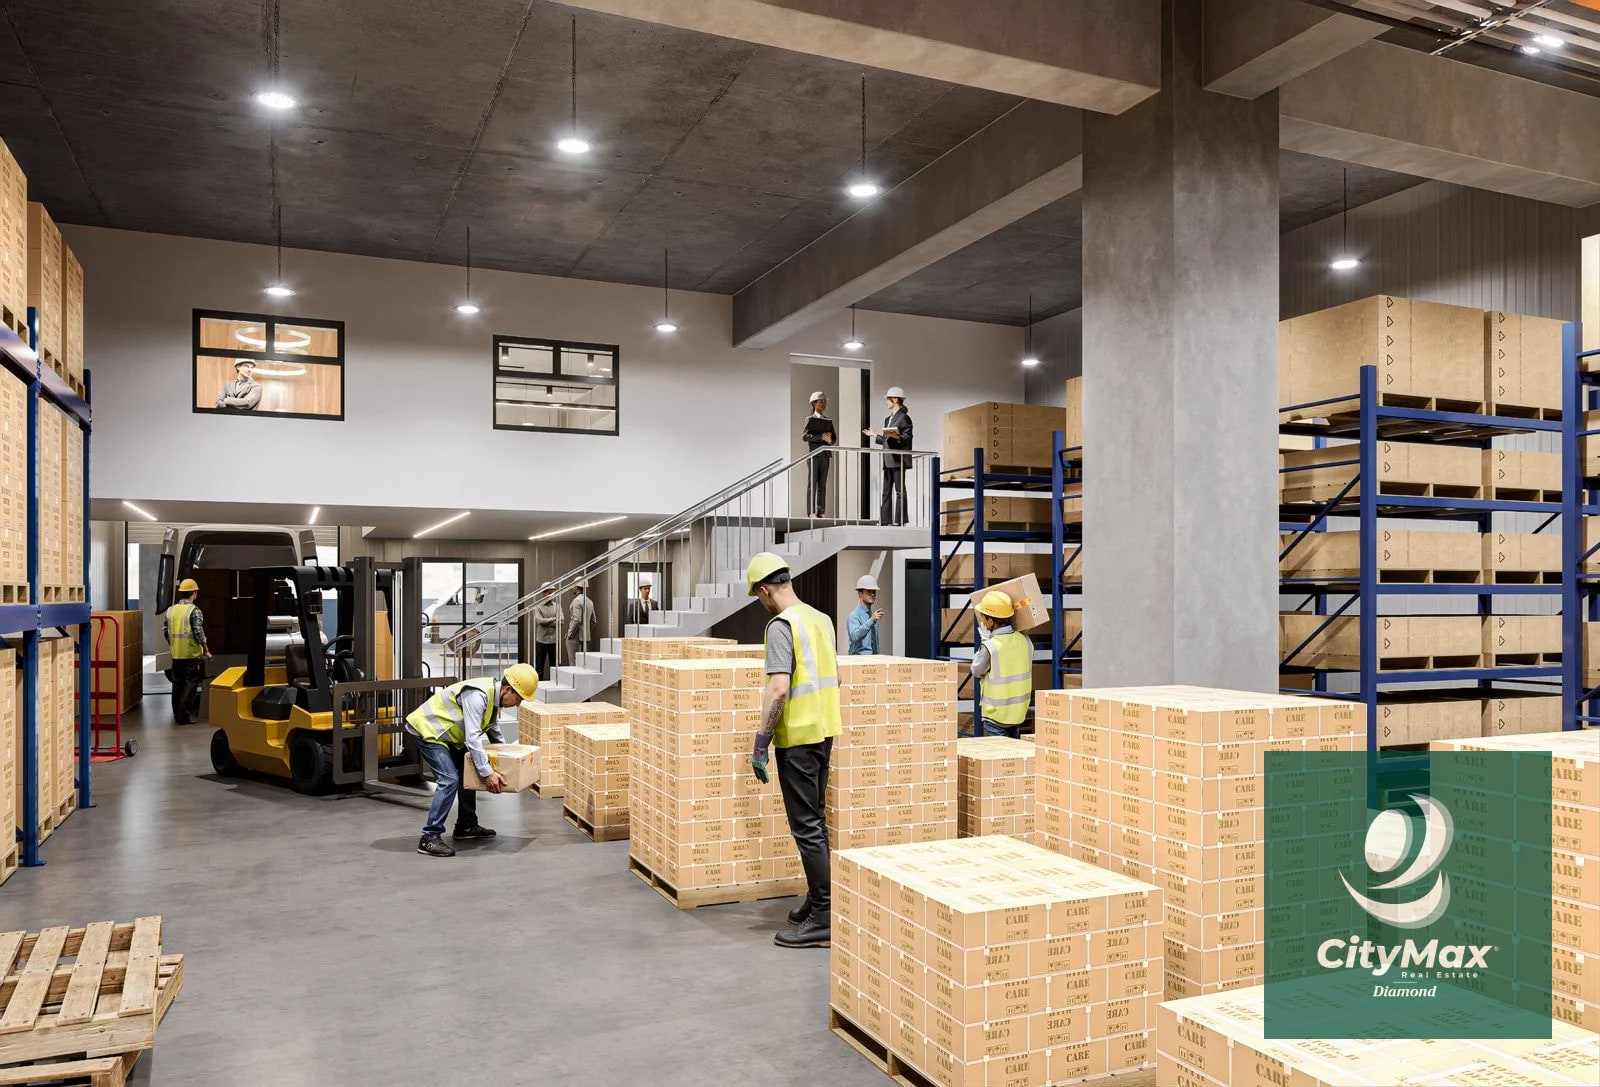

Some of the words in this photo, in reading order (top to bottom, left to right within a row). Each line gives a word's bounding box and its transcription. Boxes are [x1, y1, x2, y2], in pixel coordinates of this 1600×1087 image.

[1082, 703, 1098, 712] CARE
[1123, 709, 1140, 718] CARE
[1286, 713, 1305, 722] CARE
[1168, 715, 1187, 724] CARE
[1236, 717, 1255, 725] CARE
[1045, 727, 1059, 735] CARE
[1082, 734, 1098, 742] CARE
[1123, 741, 1140, 750] CARE
[1168, 749, 1187, 758] CARE
[1045, 756, 1059, 764] CARE
[1082, 764, 1098, 772] CARE
[1123, 773, 1140, 782] CARE
[1544, 766, 1582, 781] CARE
[1045, 784, 1059, 793] CARE
[1168, 782, 1187, 791] CARE
[1236, 785, 1255, 793] CARE
[1082, 794, 1098, 802] CARE
[1123, 804, 1140, 814] CARE
[1045, 814, 1059, 822] CARE
[1168, 815, 1187, 825] CARE
[1544, 814, 1582, 830] CARE
[1082, 823, 1098, 833] CARE
[1123, 835, 1140, 845] CARE
[1045, 842, 1059, 850] CARE
[1168, 848, 1187, 859] CARE
[1236, 851, 1255, 860] CARE
[1083, 854, 1097, 864] CARE
[1123, 867, 1139, 878] CARE
[1544, 861, 1582, 879] CARE
[1168, 881, 1187, 893] CARE
[1236, 885, 1255, 894] CARE
[1125, 899, 1147, 909] CARE
[1067, 906, 1089, 917] CARE
[1006, 914, 1030, 925] CARE
[1168, 915, 1187, 926] CARE
[1544, 909, 1582, 927] CARE
[1168, 948, 1187, 960] CARE
[1236, 952, 1255, 961] CARE
[1544, 956, 1582, 975] CARE
[1125, 969, 1147, 980] CARE
[1067, 978, 1089, 989] CARE
[1168, 981, 1187, 994] CARE
[1006, 988, 1030, 999] CARE
[1544, 1003, 1582, 1024] CARE
[1177, 1025, 1207, 1048] CARE
[1125, 1040, 1147, 1051] CARE
[1067, 1051, 1089, 1062] CARE
[1006, 1063, 1030, 1075] CARE
[1256, 1063, 1290, 1087] CARE
